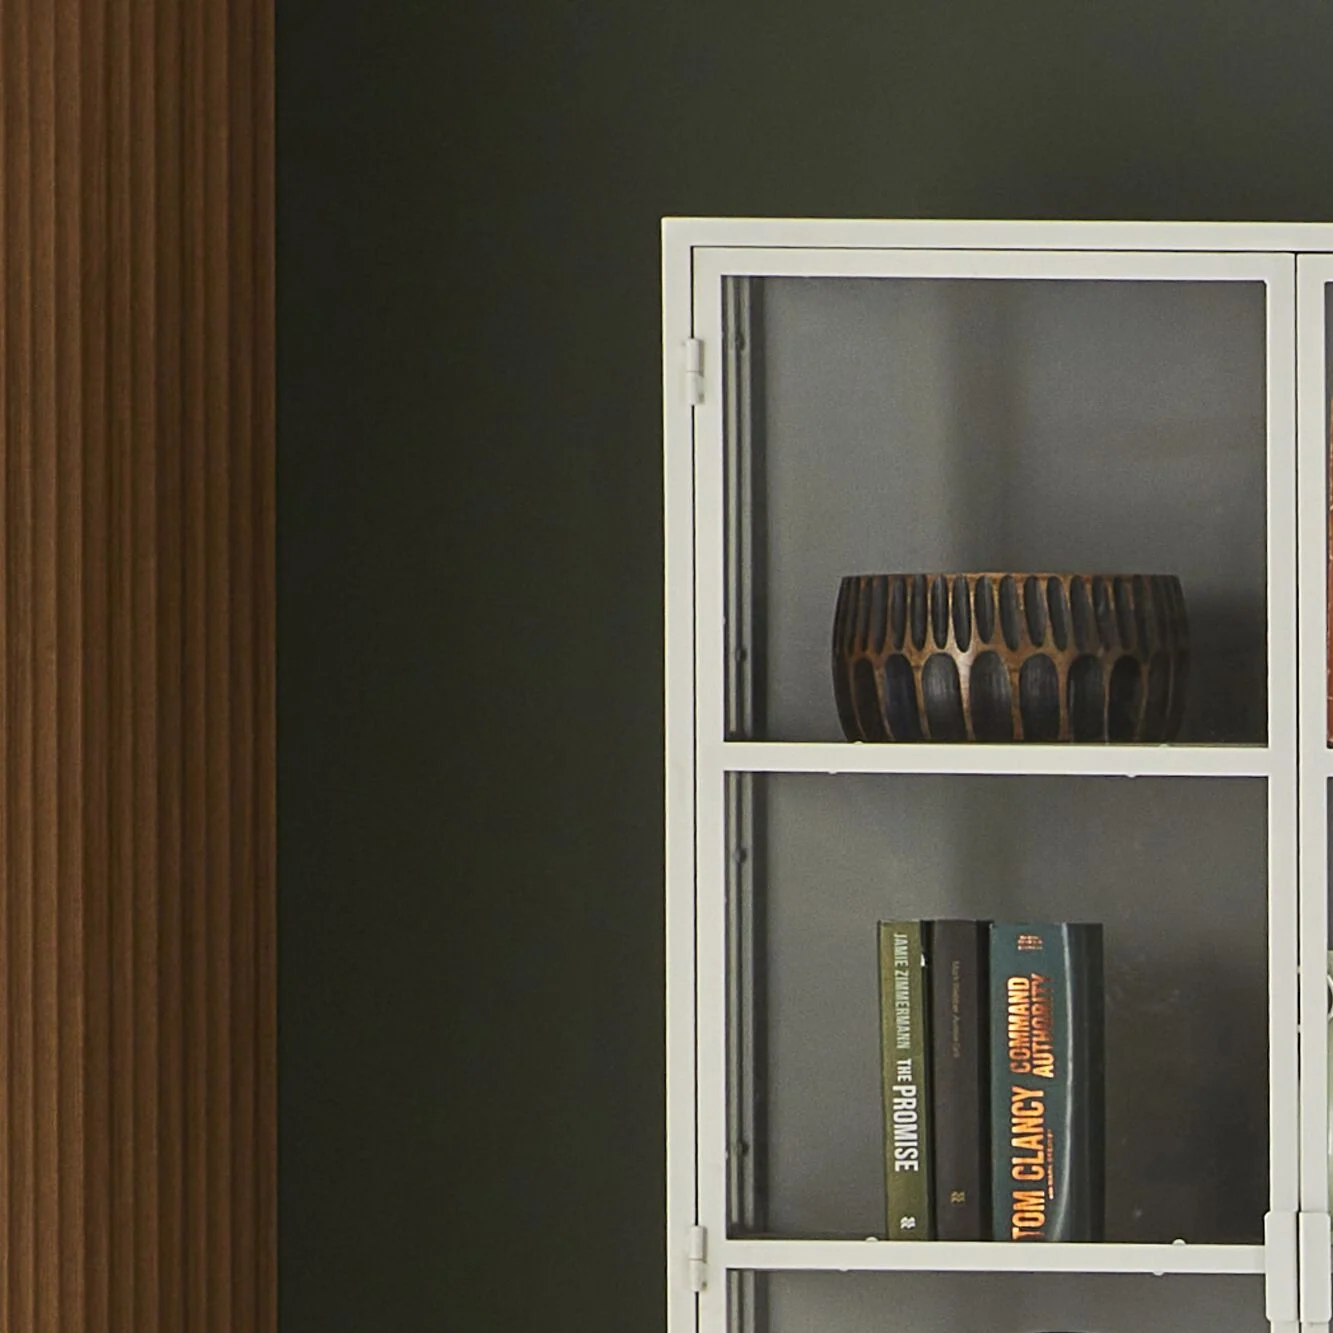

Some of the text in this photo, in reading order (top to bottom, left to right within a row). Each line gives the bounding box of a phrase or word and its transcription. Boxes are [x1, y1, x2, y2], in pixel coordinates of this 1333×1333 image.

[892, 933, 919, 1172] JAMIE ZIMMERMANN THE PROMISE
[1007, 976, 1030, 1073] COMMAND
[1032, 973, 1054, 1078] AUTHORITY
[1011, 1086, 1046, 1240] TOM CLANCY
